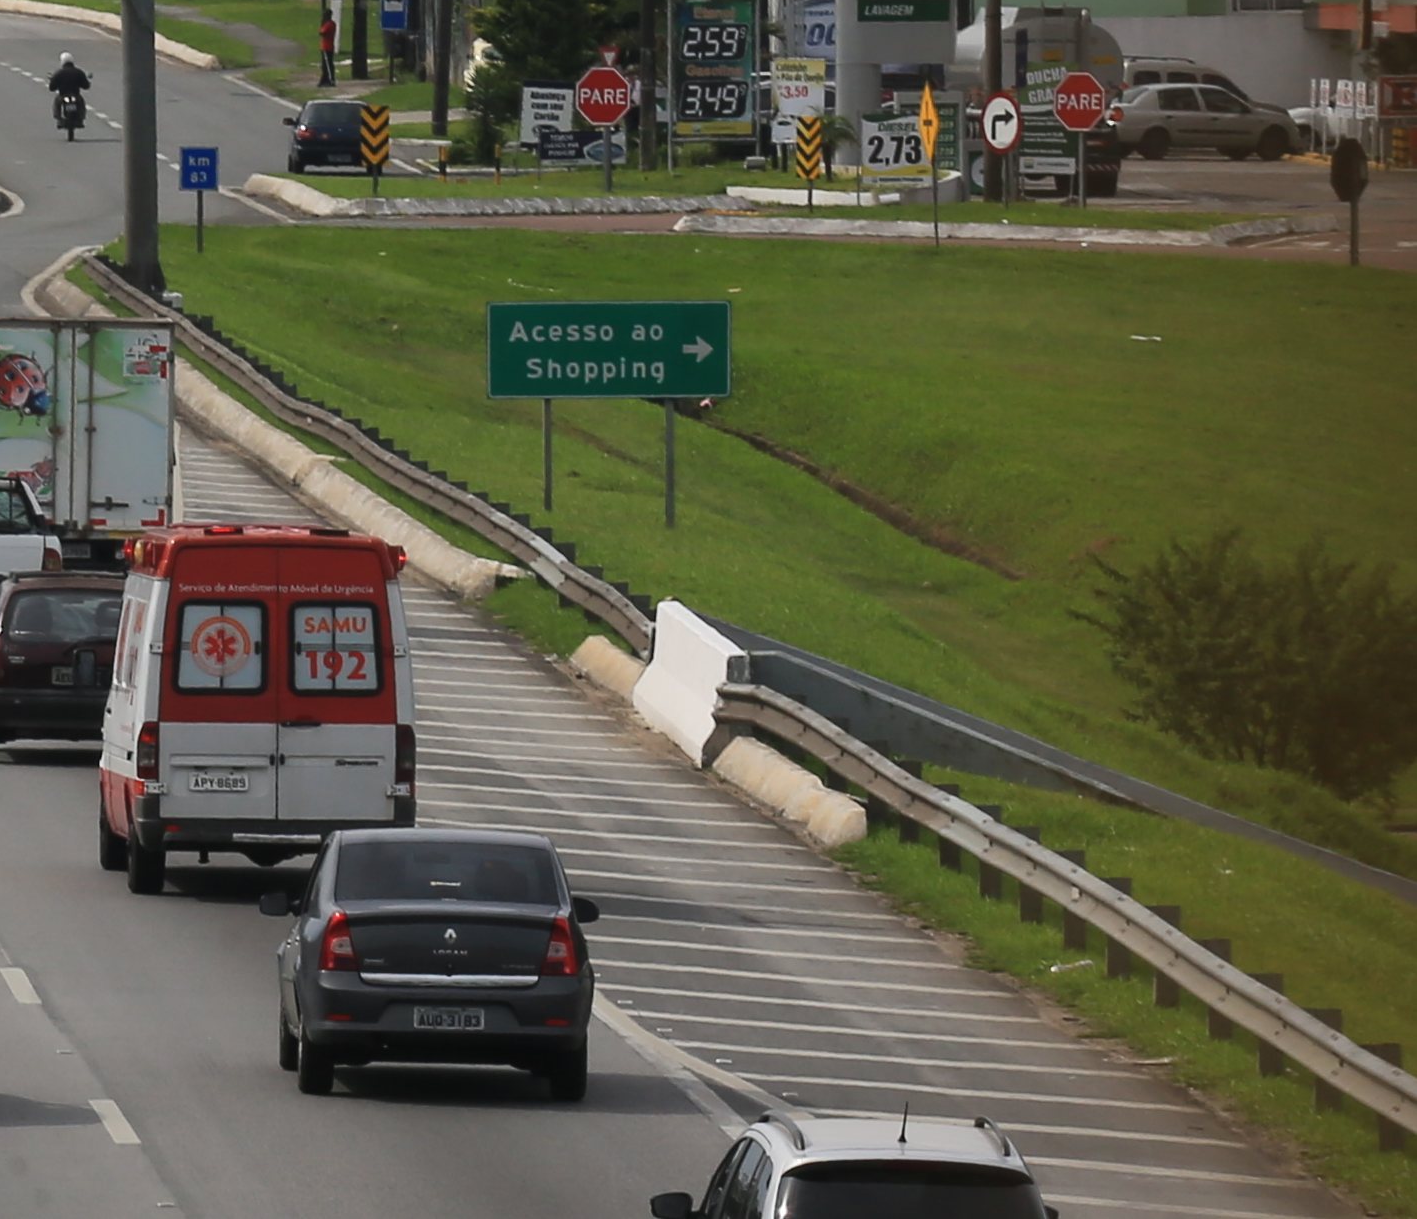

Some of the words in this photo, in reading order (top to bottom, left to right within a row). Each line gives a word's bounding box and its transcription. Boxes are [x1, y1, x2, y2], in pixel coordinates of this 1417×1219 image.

[864, 4, 914, 16] LAVAGEM
[683, 27, 739, 60] 2,59
[580, 88, 626, 105] PARE
[685, 85, 739, 117] 3,49
[1057, 94, 1101, 110] PARE
[868, 135, 922, 167] 2,73
[509, 321, 613, 343] Acesso
[631, 324, 663, 341] ao
[526, 357, 665, 383] Shopping
[178, 583, 212, 593] Serviço
[214, 583, 226, 592] de
[290, 584, 319, 593] Móvel
[320, 584, 332, 593] de
[334, 585, 374, 595] Urgência
[304, 616, 367, 634] SAMU
[304, 650, 367, 680] 192
